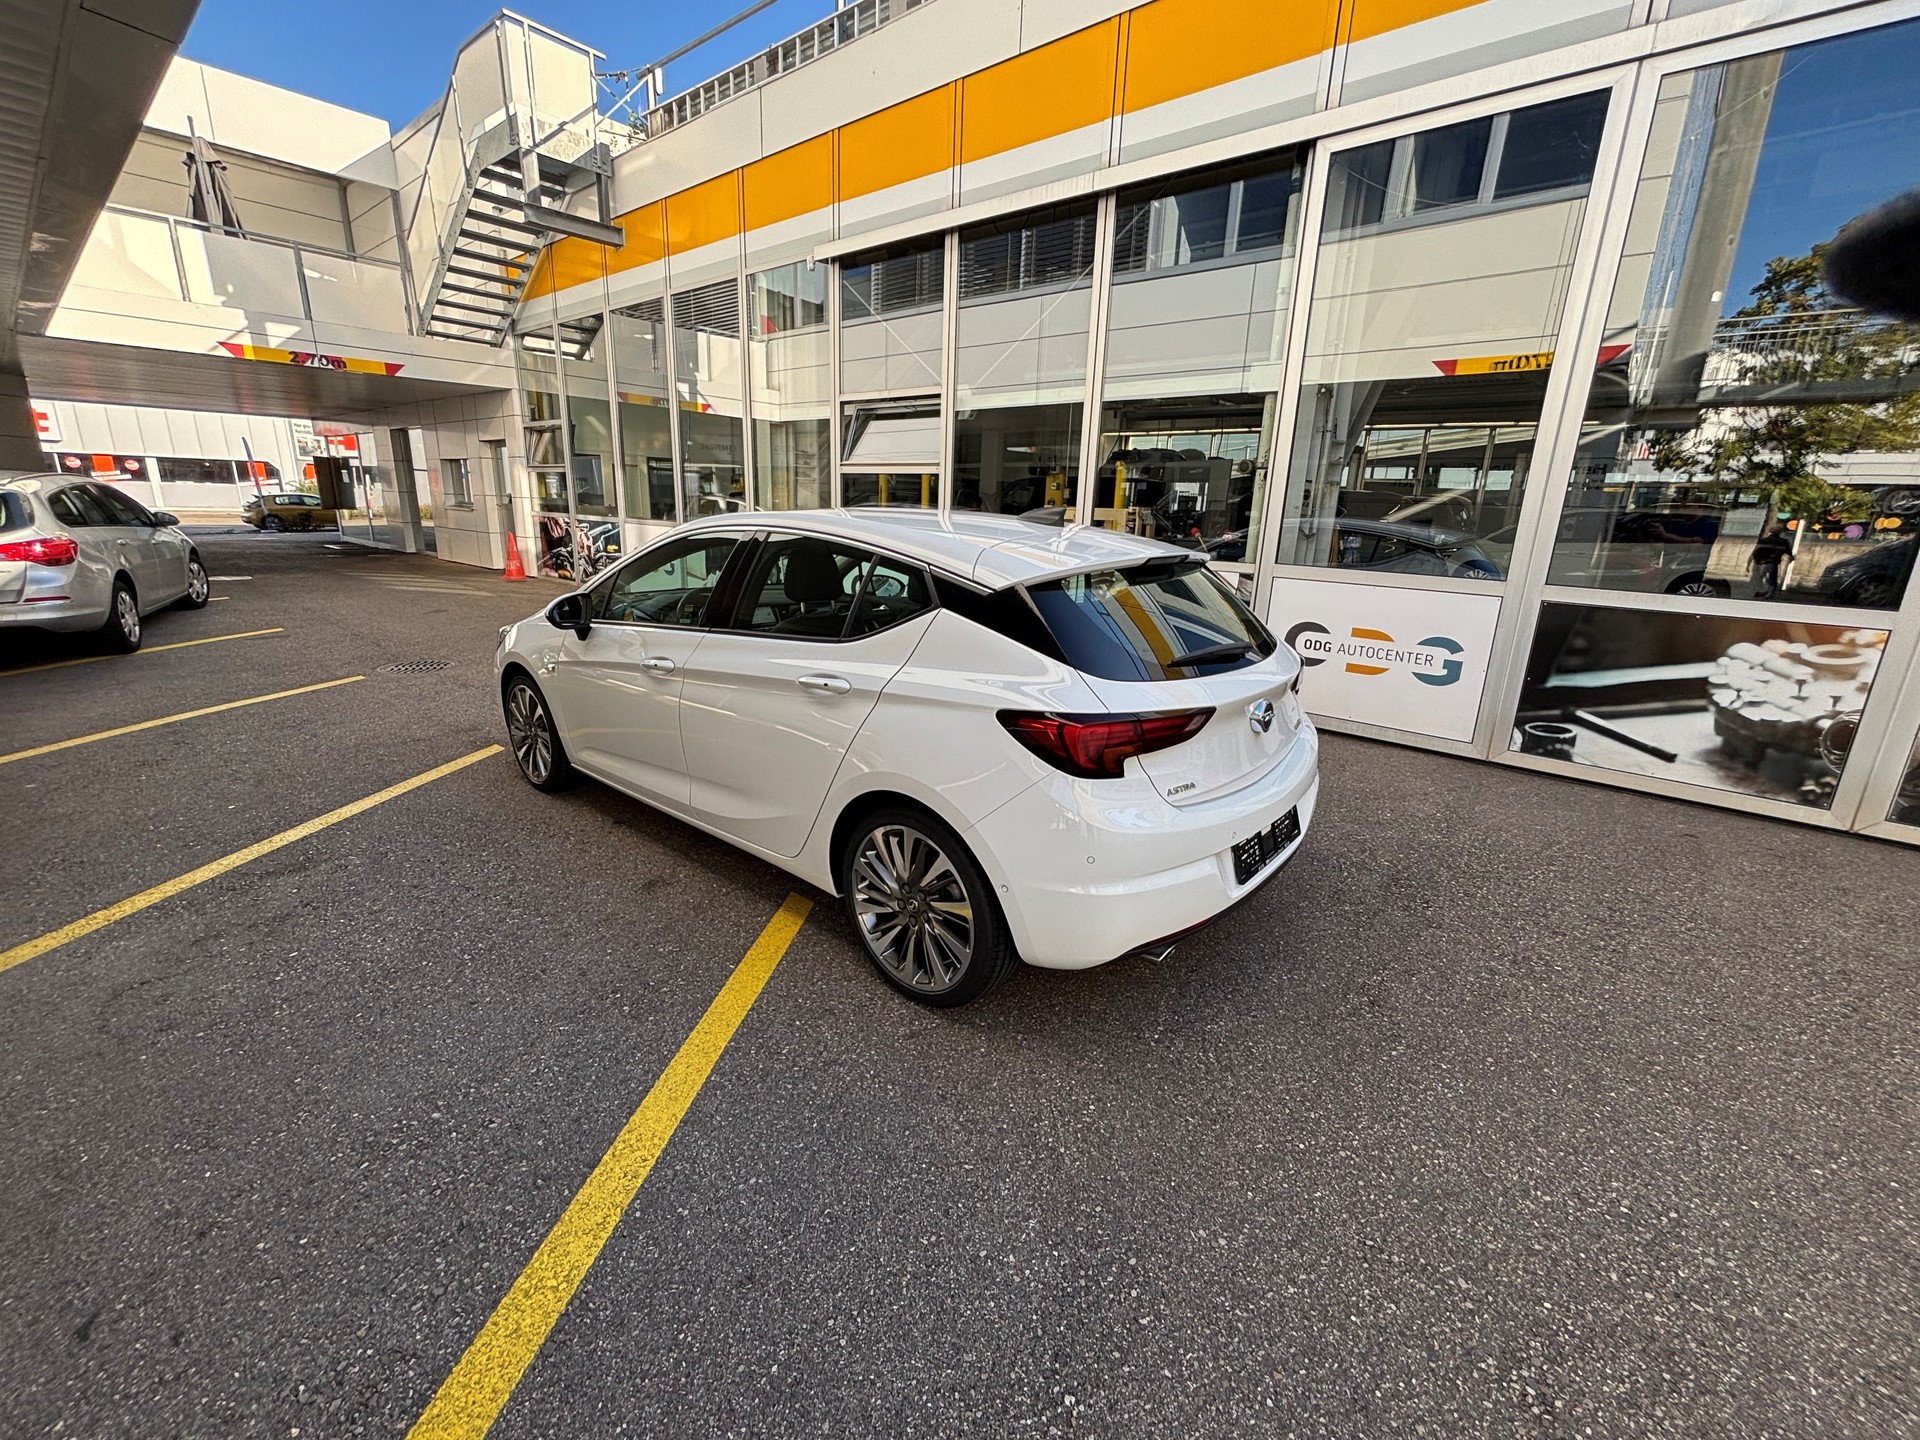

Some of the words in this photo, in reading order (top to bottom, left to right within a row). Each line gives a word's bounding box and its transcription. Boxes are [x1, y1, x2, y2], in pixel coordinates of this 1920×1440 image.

[1303, 638, 1332, 653] ODG
[1336, 643, 1434, 667] AUTOCENTER
[1166, 781, 1197, 797] ASTRA
